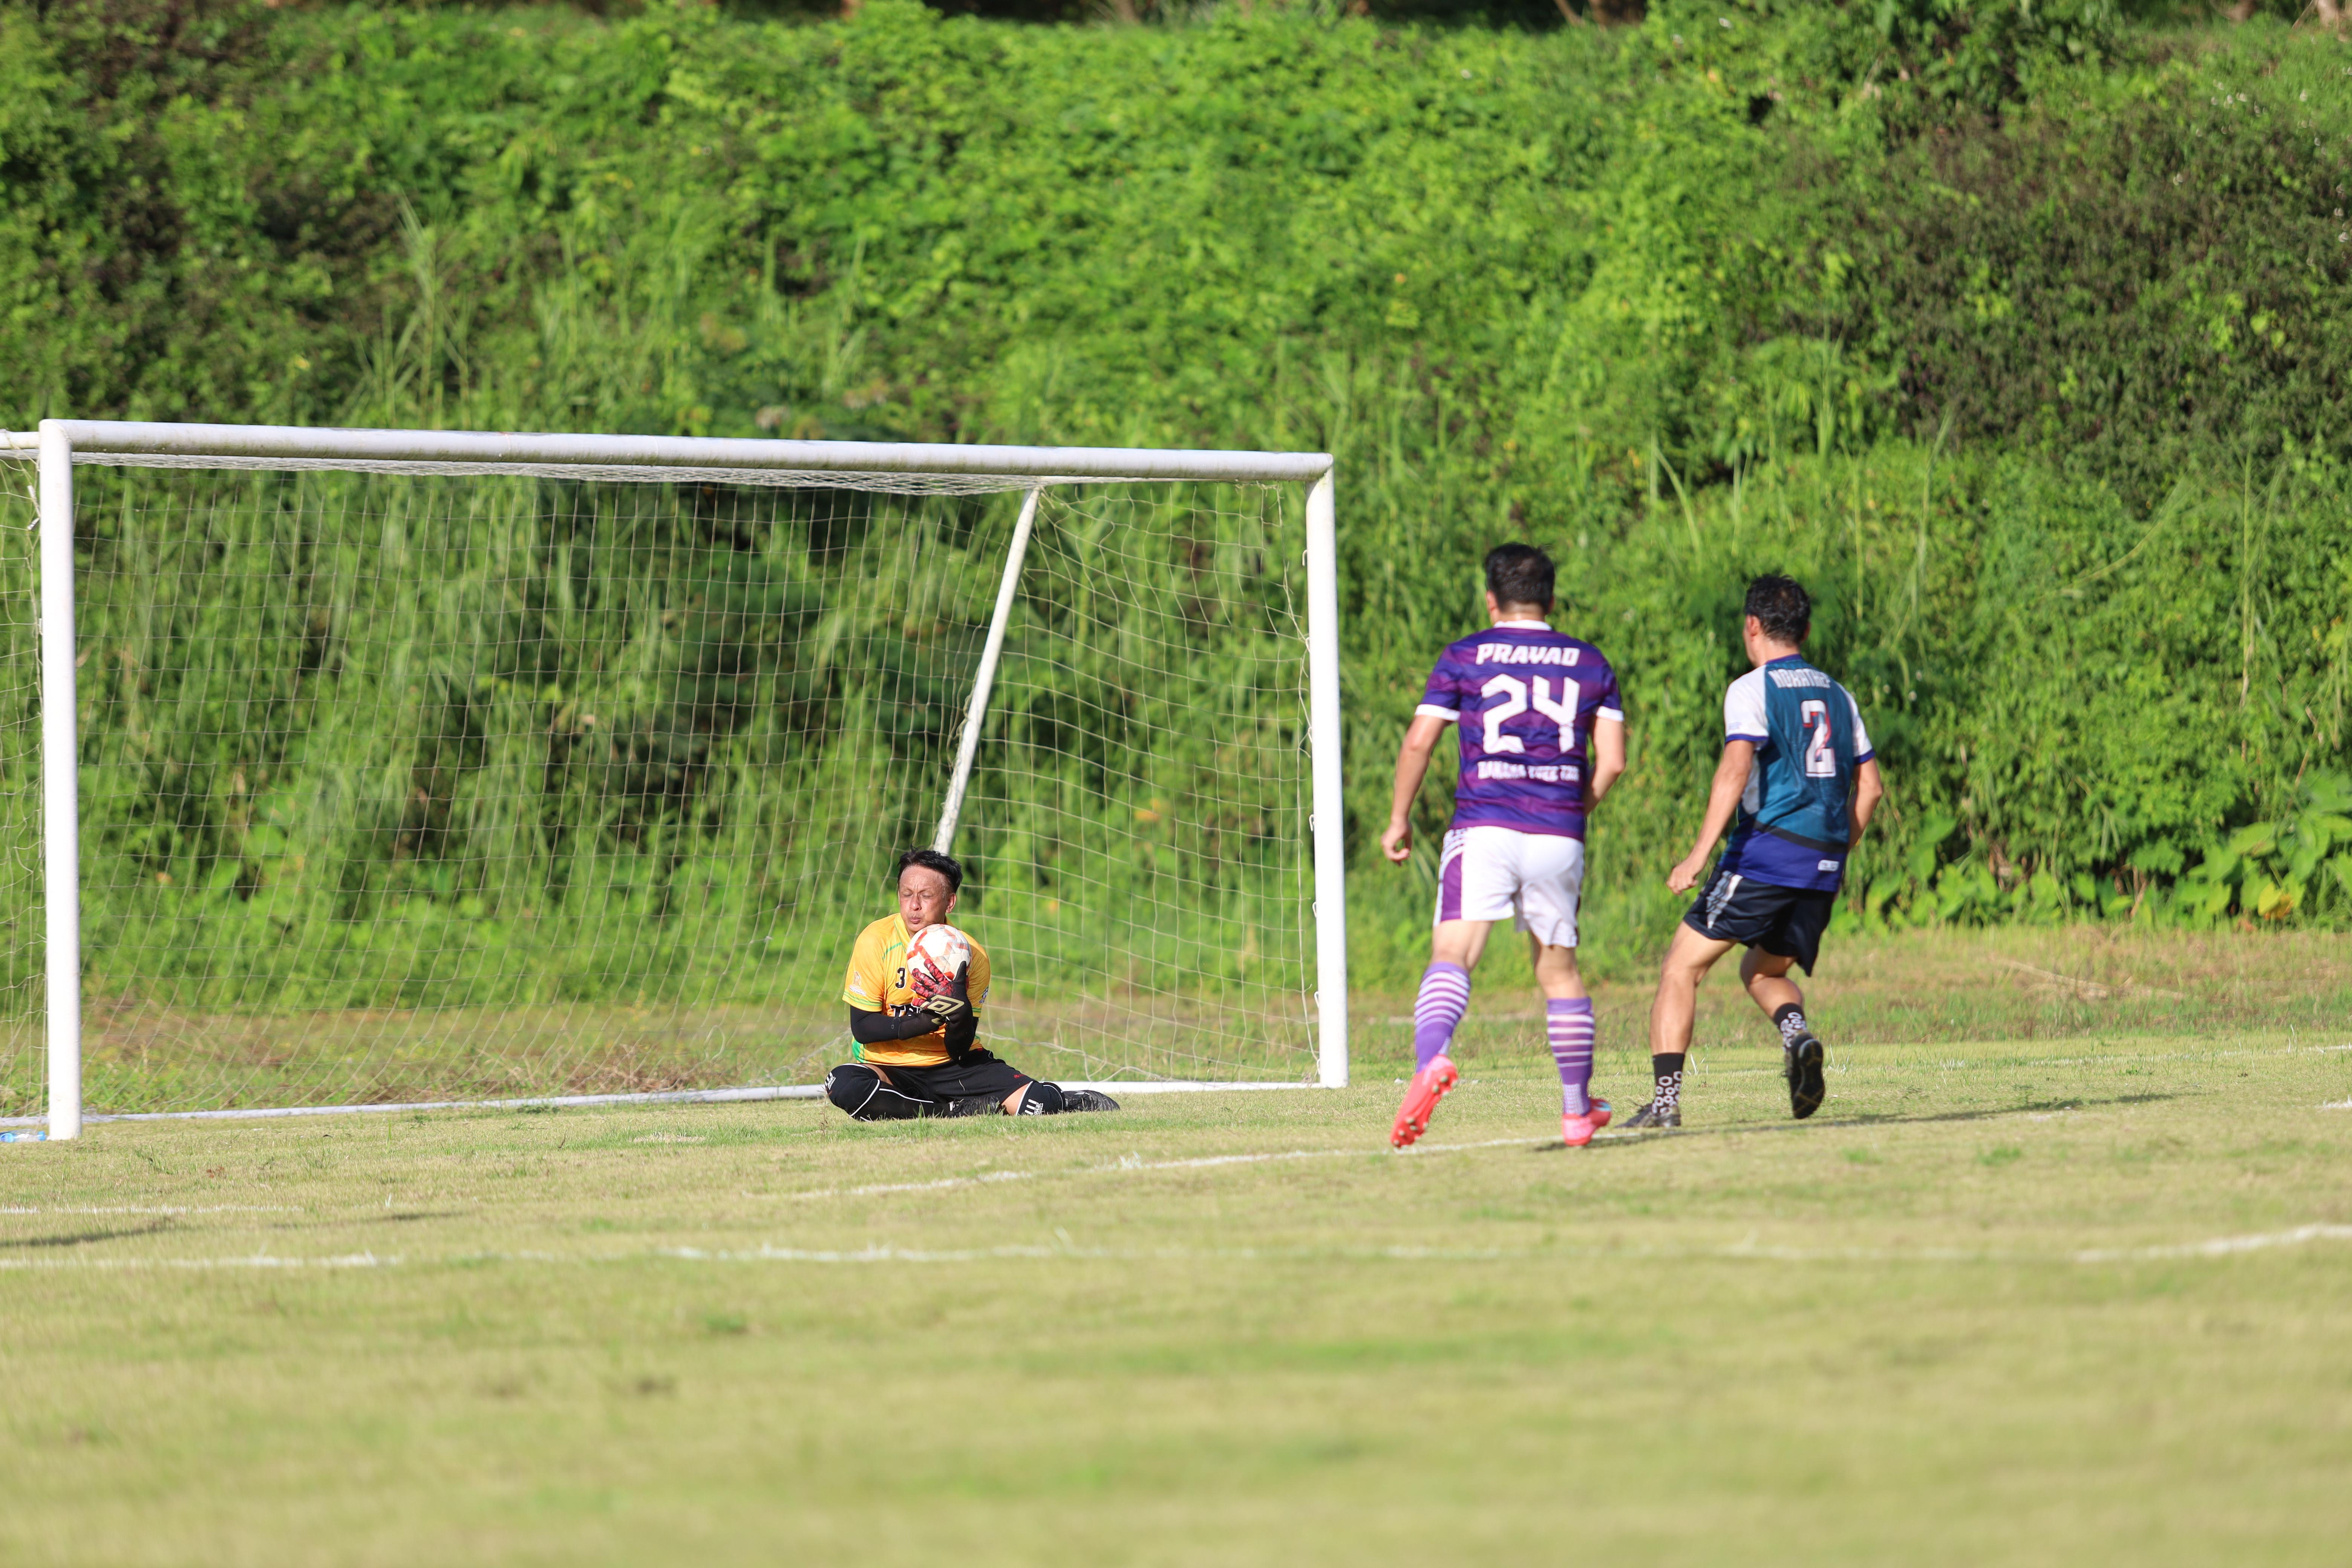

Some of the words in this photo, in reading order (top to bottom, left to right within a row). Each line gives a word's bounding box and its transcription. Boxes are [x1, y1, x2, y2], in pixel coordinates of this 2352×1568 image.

[1475, 643, 1580, 667] PRAYAD
[1481, 673, 1580, 754] 24
[1801, 700, 1836, 778] 2
[895, 967, 906, 989] 3
